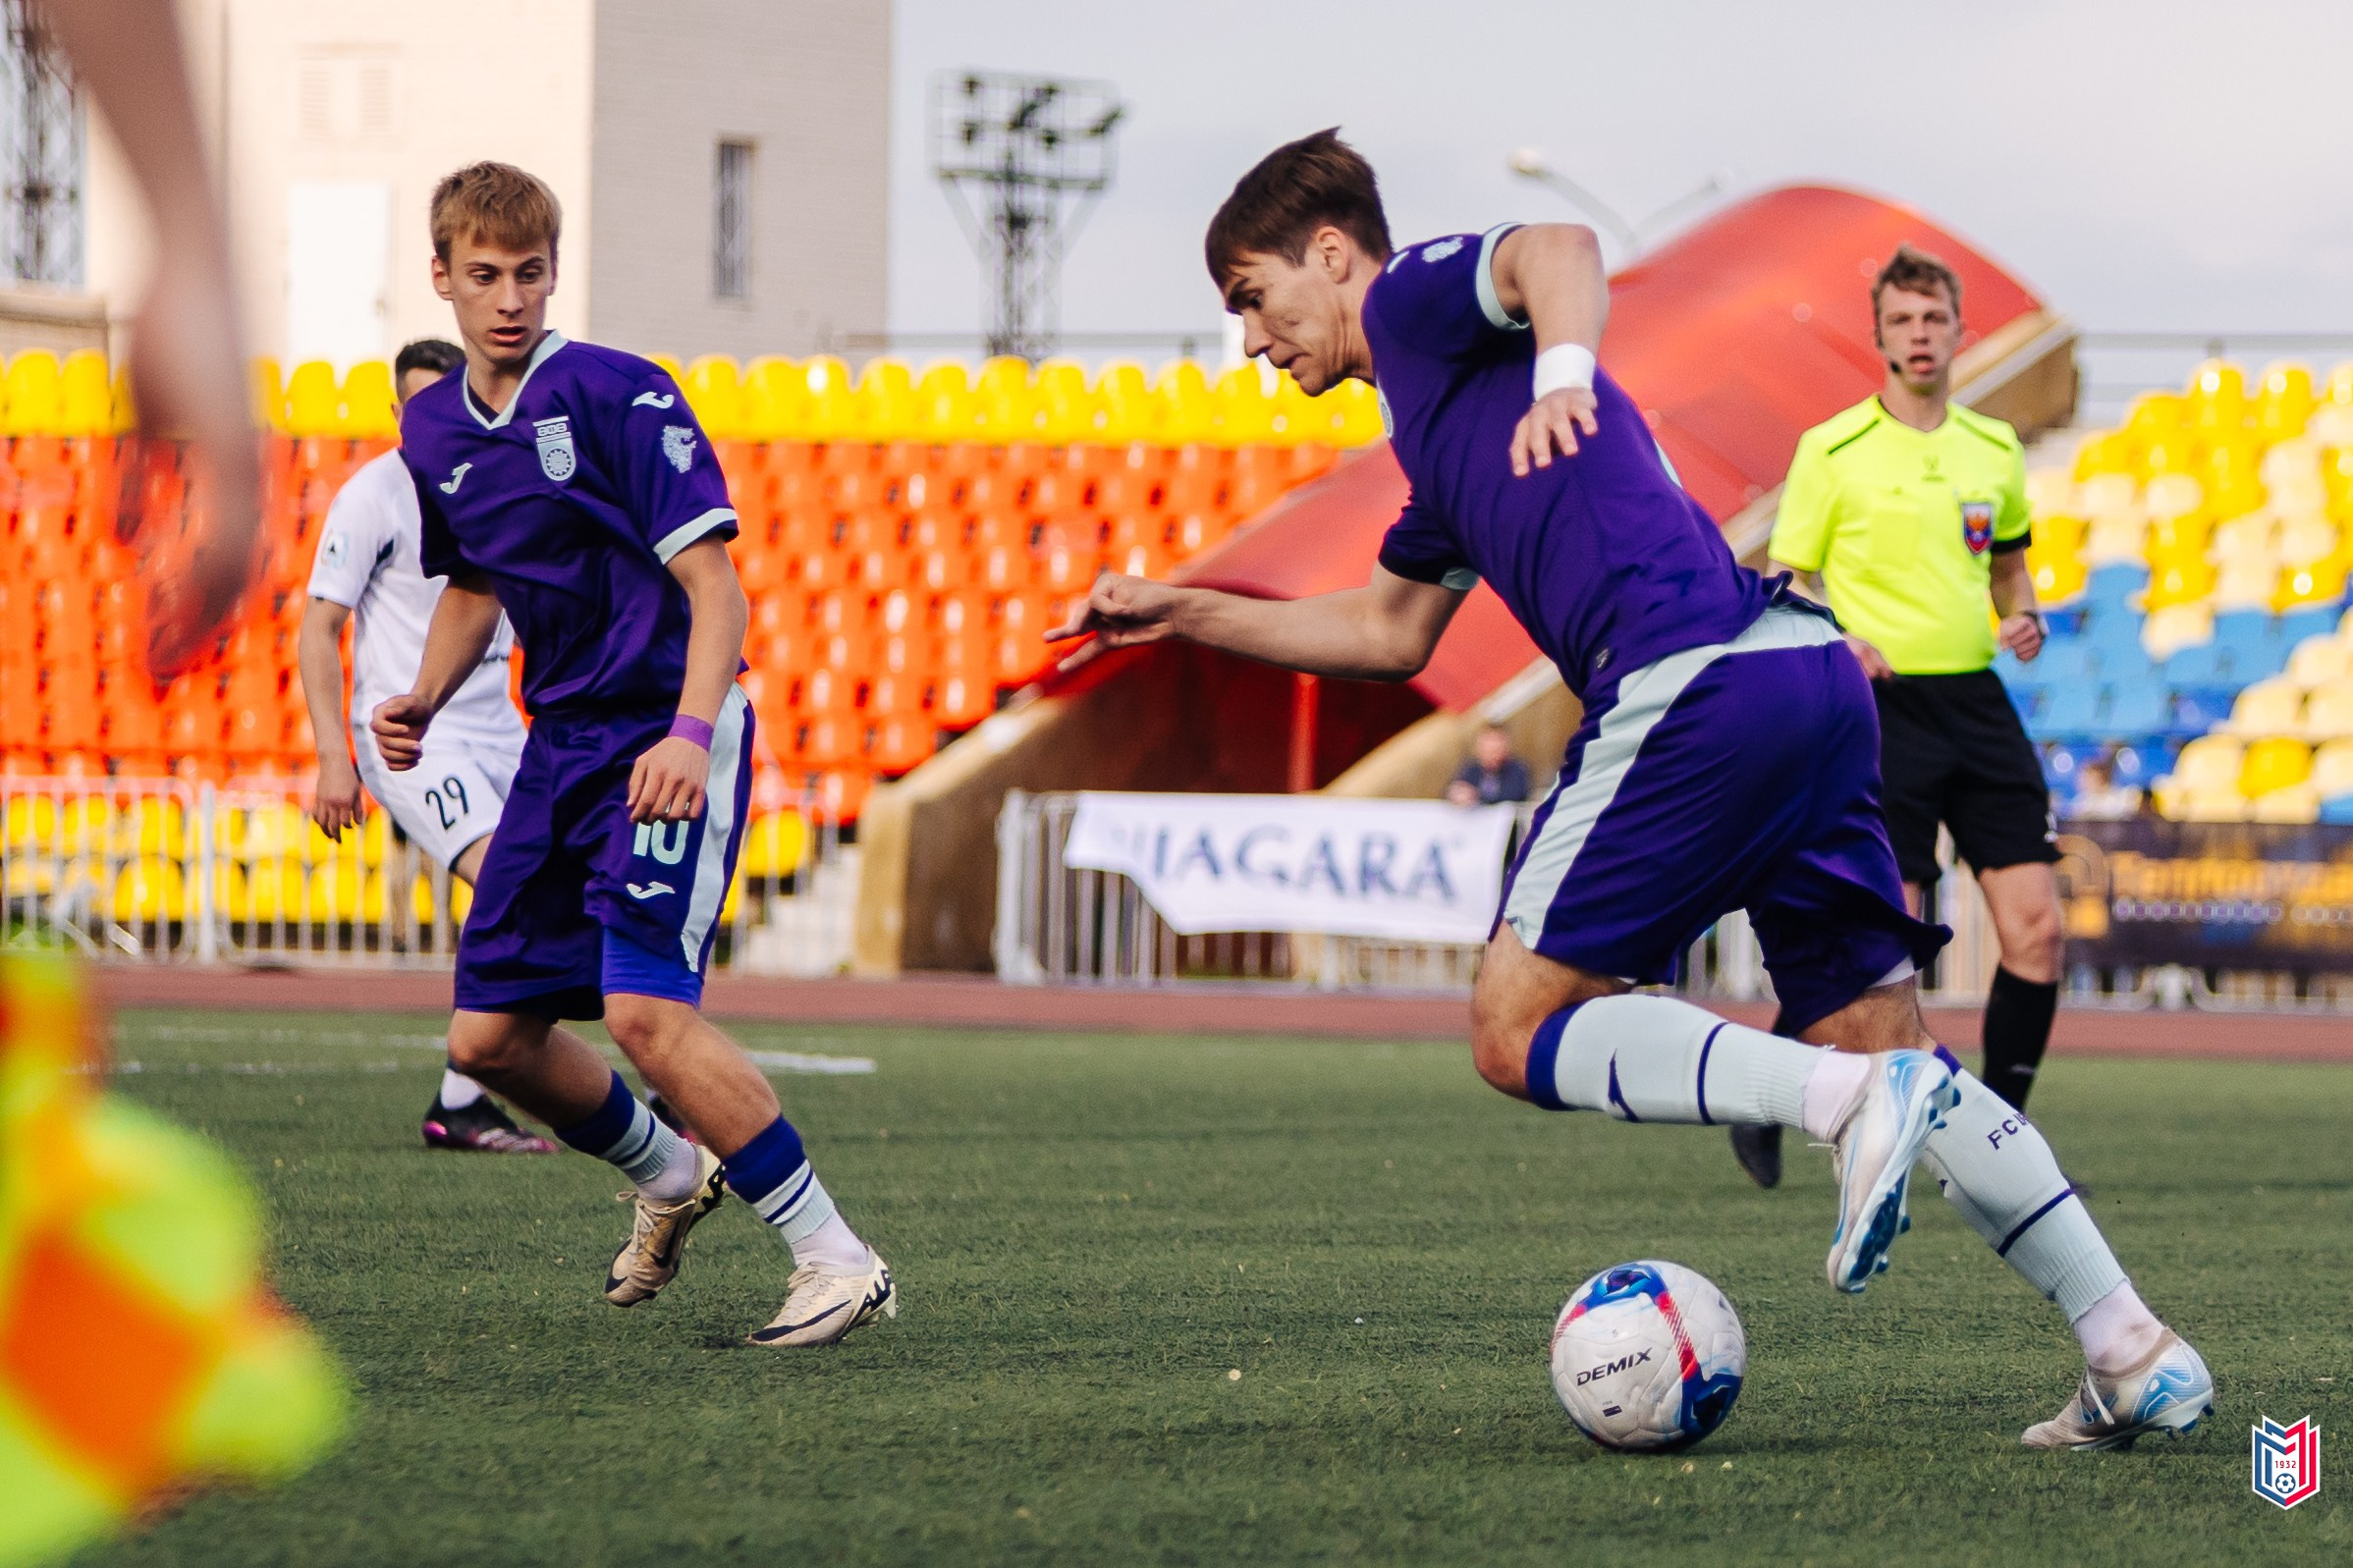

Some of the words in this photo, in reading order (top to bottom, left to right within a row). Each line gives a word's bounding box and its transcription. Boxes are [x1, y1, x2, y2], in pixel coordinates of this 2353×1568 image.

[425, 777, 468, 831] 29
[1108, 822, 1458, 901] IAGARA
[1576, 1346, 1653, 1386] DEMIX
